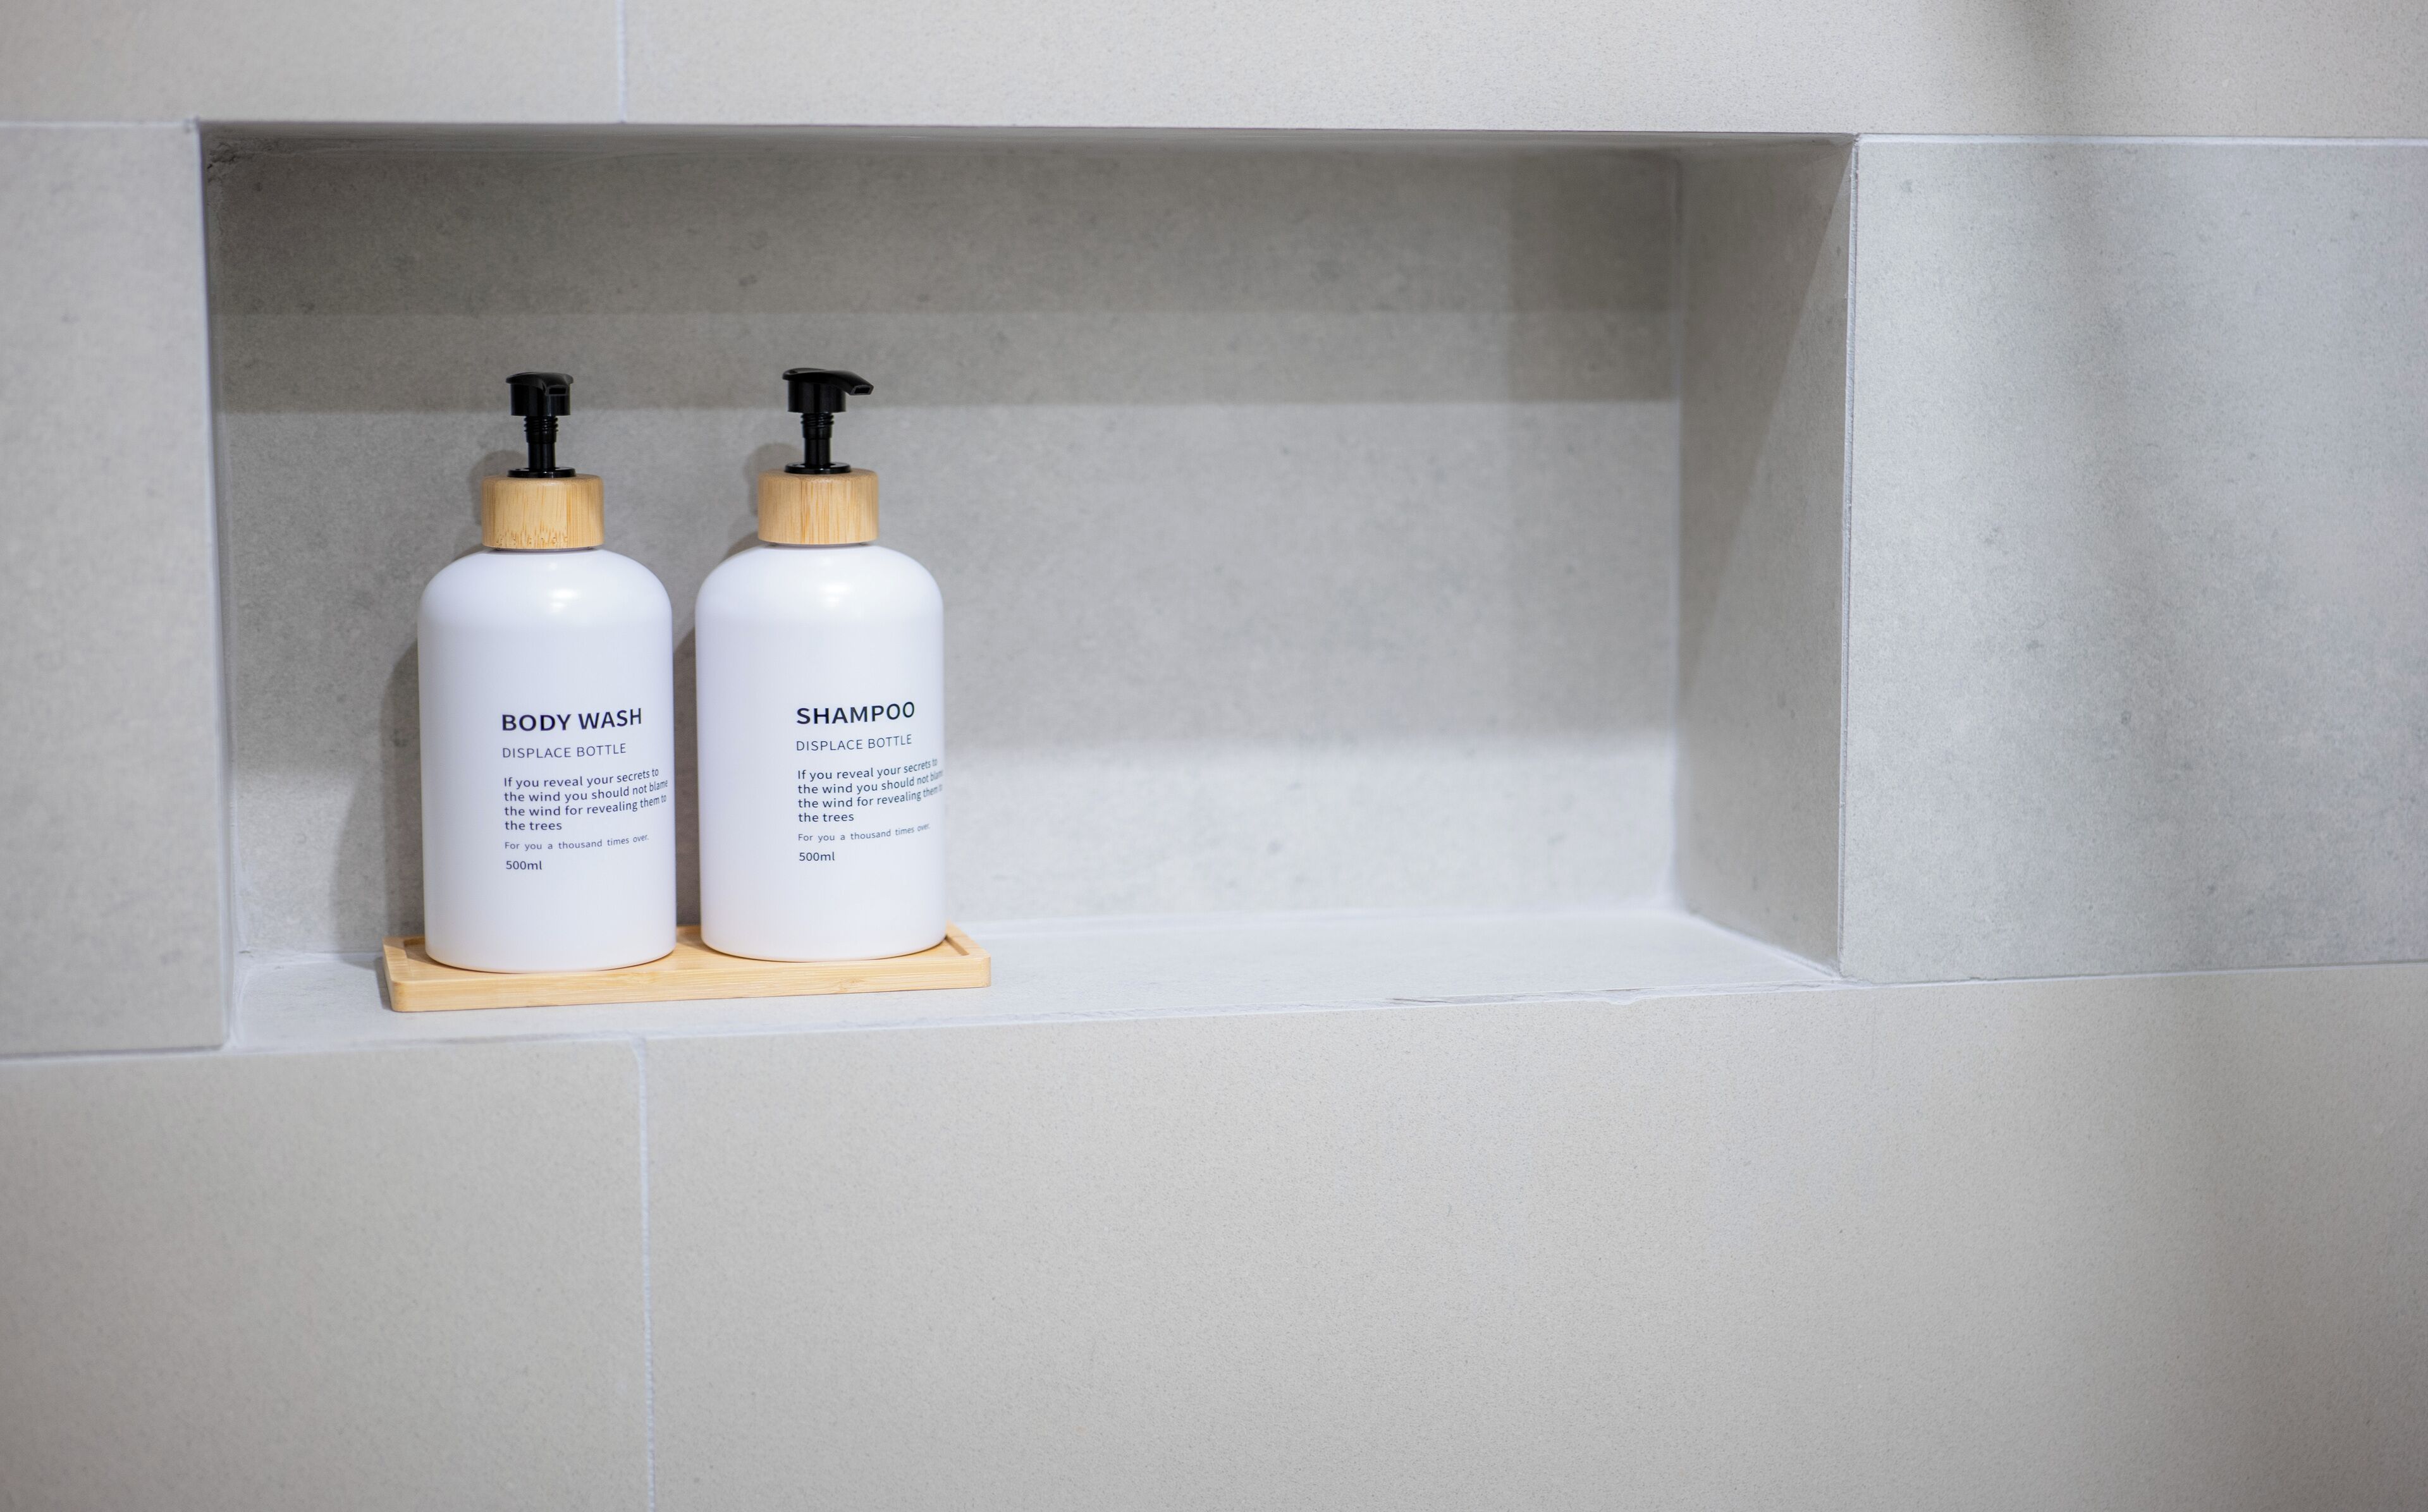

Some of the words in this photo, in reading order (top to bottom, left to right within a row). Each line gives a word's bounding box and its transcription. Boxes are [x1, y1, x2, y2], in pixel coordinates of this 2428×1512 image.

[501, 714, 572, 731] BODY
[579, 708, 642, 729] WASH
[796, 702, 914, 724] SHAMPOO
[503, 747, 572, 759] DISPLACE
[577, 743, 626, 757] BOTTLE
[797, 739, 863, 751] DISPLACE
[868, 734, 912, 748] BOTTLE
[504, 777, 512, 787] If
[516, 779, 539, 790] you
[544, 776, 583, 788] reveal
[587, 776, 613, 788] your
[616, 770, 650, 783] secrets
[652, 768, 659, 777] to
[798, 770, 806, 779] If
[809, 771, 832, 782] you
[837, 768, 873, 779] reveal
[877, 765, 900, 779] your
[904, 760, 931, 774] secrets
[504, 792, 525, 802] the
[529, 791, 560, 802] wind
[565, 793, 587, 803] you
[592, 786, 629, 800] should
[632, 784, 647, 795] not
[649, 779, 668, 792] blame
[797, 784, 818, 794] the
[822, 784, 852, 793] wind
[857, 784, 877, 795] you
[881, 777, 914, 790] should
[917, 775, 929, 785] not
[505, 807, 525, 816] the
[529, 806, 561, 816] wind
[565, 805, 583, 815] for
[587, 801, 638, 814] revealing
[640, 797, 659, 808] them
[661, 794, 666, 803] to
[798, 798, 818, 808] the
[823, 798, 852, 808] wind
[857, 797, 874, 807] for
[877, 791, 921, 805] revealing
[505, 821, 525, 831] the
[530, 822, 562, 831] trees
[798, 813, 819, 822] the
[823, 814, 854, 822] trees
[850, 829, 891, 840] thousand
[895, 827, 914, 836] times
[505, 842, 519, 850] For
[524, 843, 542, 851] you
[558, 839, 602, 850] thousand
[607, 837, 629, 846] times
[506, 860, 543, 870] 500ml
[799, 852, 835, 862] 500ml
